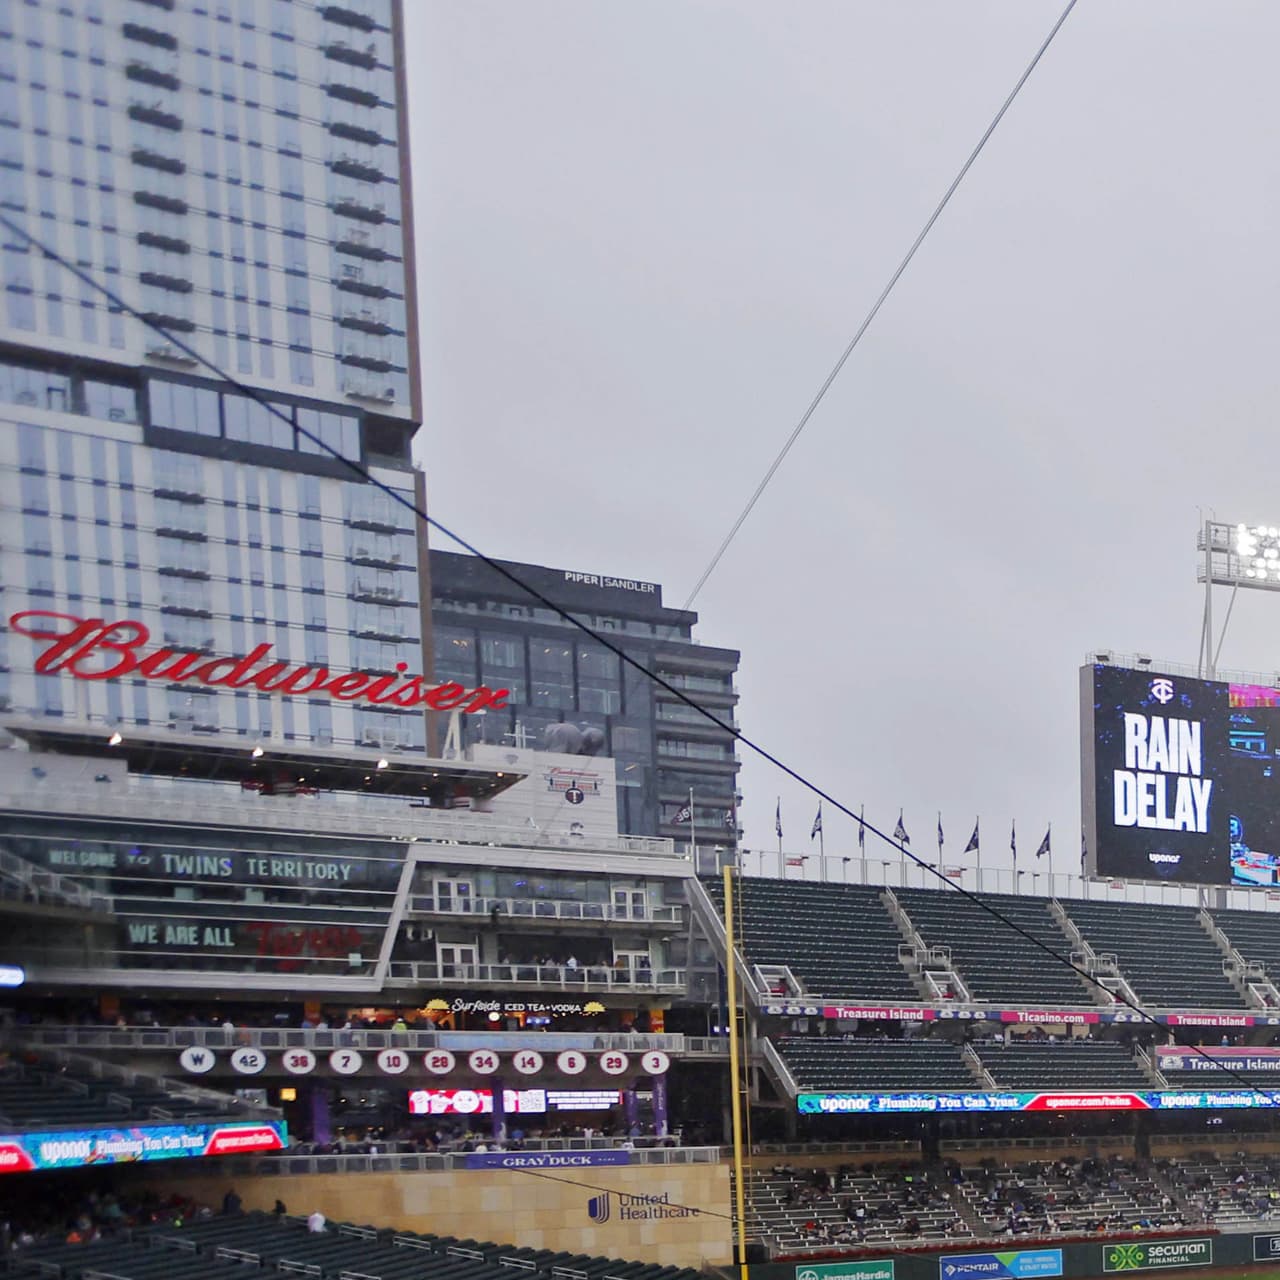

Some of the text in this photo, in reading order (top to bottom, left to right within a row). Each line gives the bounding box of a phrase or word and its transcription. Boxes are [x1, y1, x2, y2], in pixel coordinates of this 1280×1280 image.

[564, 571, 656, 593] PIPER SANDLER
[9, 609, 509, 713] Budweiser
[1123, 711, 1202, 776] RAIN
[1113, 768, 1213, 833] DELAY
[1149, 853, 1181, 864] uponor
[161, 853, 233, 877] TWINS
[246, 858, 352, 881] TERRITORY
[128, 923, 236, 947] WE ARE ALL
[451, 998, 525, 1013] Surfside ICED
[835, 1007, 924, 1020] Treasure Island
[1177, 1015, 1246, 1027] Treasure Island
[238, 1053, 258, 1068] 42
[341, 1053, 350, 1068] 7
[386, 1053, 401, 1068] 10
[431, 1056, 449, 1069] 28
[475, 1056, 494, 1069] 34
[520, 1056, 536, 1069] 14
[567, 1056, 576, 1069] 6
[606, 1056, 622, 1069] 29
[651, 1056, 660, 1069] 3
[1189, 1058, 1244, 1070] Treasure
[819, 1097, 870, 1111] uponor
[878, 1096, 936, 1109] Plumbing
[938, 1097, 962, 1108] You
[963, 1097, 985, 1107] Can
[987, 1096, 1019, 1107] Trust
[1160, 1094, 1201, 1108] uponor
[1206, 1094, 1251, 1107] Plumbing
[1254, 1094, 1272, 1106] You
[40, 1139, 91, 1162] uponor
[502, 1155, 592, 1168] GRAY DUCK
[619, 1191, 669, 1207] United
[619, 1205, 701, 1221] Healthcare
[1148, 1242, 1206, 1257] securian
[1148, 1255, 1190, 1265] FINANCIAL
[956, 1262, 999, 1274] PENTAIR
